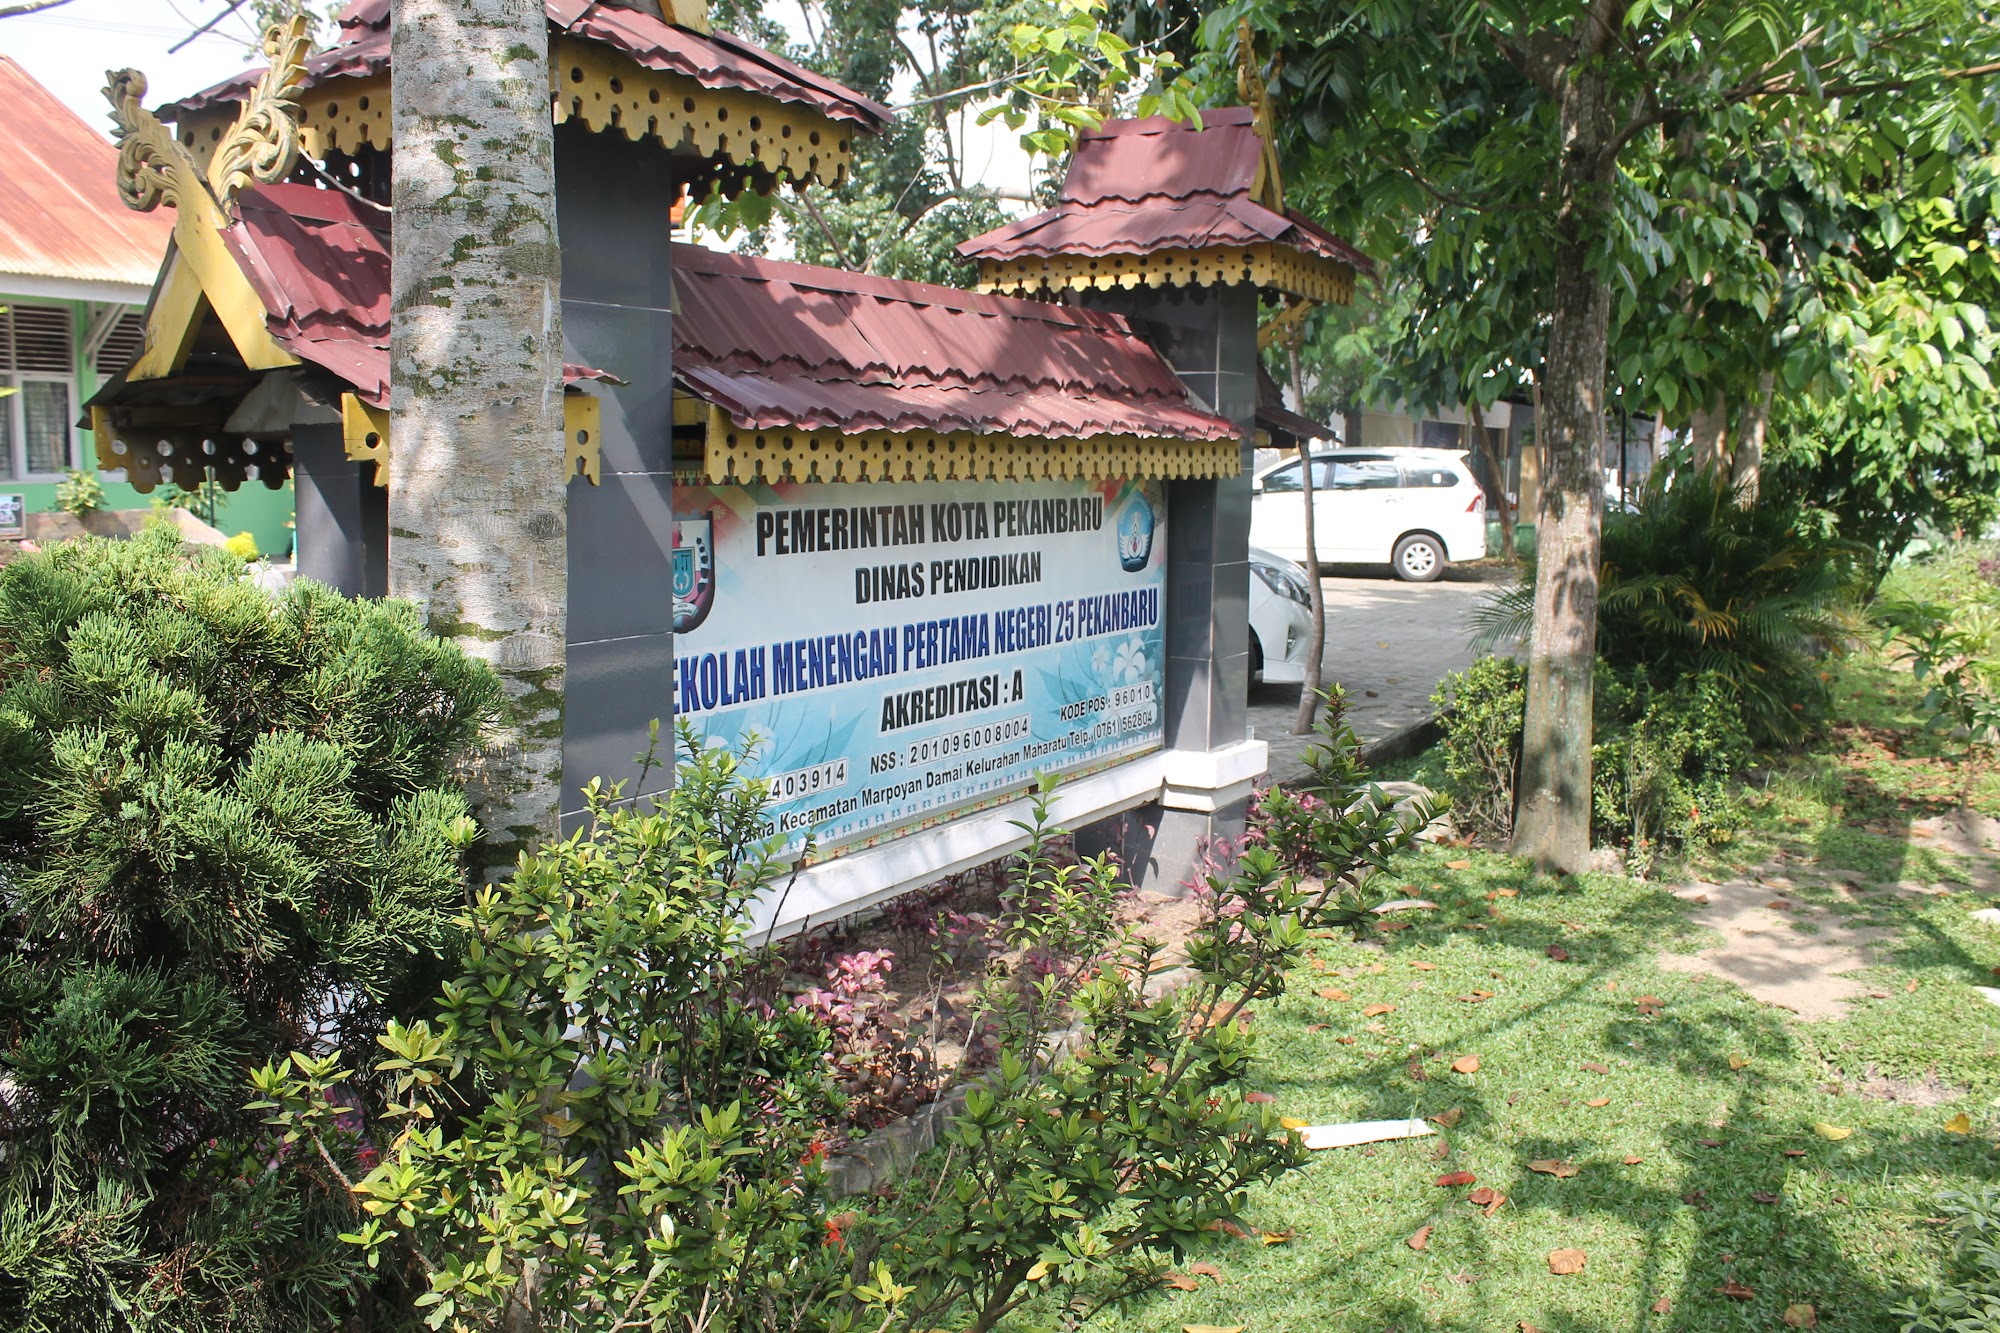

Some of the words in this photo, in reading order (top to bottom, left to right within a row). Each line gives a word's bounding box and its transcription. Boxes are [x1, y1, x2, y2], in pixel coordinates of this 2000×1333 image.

[757, 504, 925, 556] PEMERINTAH
[931, 502, 989, 543] KOTA
[993, 497, 1103, 538] PEKANBARU
[855, 561, 925, 604] DINAS
[930, 551, 1042, 595] PENDIDIKAN
[772, 626, 897, 696] MENENGAH
[903, 613, 990, 672] PERTAMA
[994, 603, 1052, 654] NEGERI
[1055, 600, 1074, 643] 25
[1077, 587, 1159, 638] PEKANBARU
[881, 673, 999, 732] AKREDITASI
[1004, 682, 1009, 704] :
[1011, 669, 1024, 702] A
[1060, 701, 1086, 722] KODE
[1088, 696, 1106, 714] POS
[1115, 685, 1150, 707] 96010
[780, 797, 858, 833] Kecamatan
[862, 779, 923, 809] Marpoyan
[926, 764, 963, 788] Damai
[966, 753, 1020, 777] Kelurahan
[1023, 735, 1068, 760] Maharatu
[1069, 730, 1091, 747] Telp.
[1093, 718, 1121, 744] (0761)
[1122, 709, 1154, 732] 562804
[870, 751, 897, 775] NSS
[910, 718, 1029, 765] 201096008004
